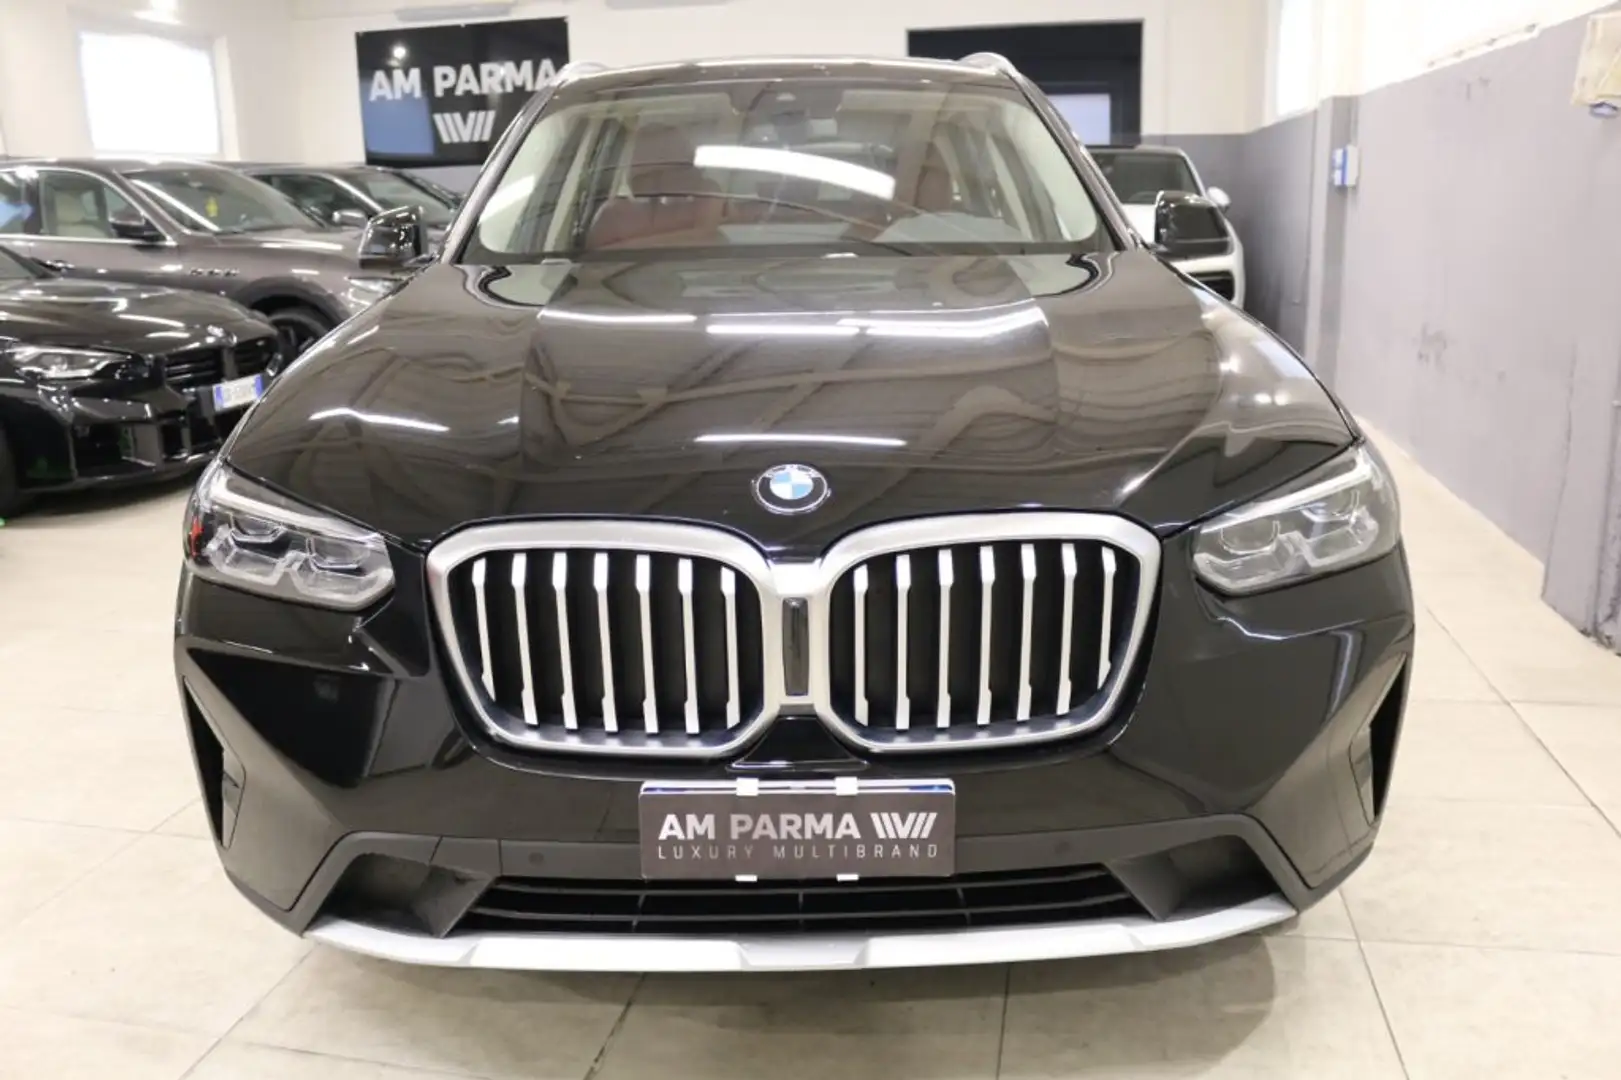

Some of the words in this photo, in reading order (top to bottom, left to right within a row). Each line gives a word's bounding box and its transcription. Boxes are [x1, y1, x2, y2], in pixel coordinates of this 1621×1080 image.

[369, 67, 422, 101] AM
[433, 58, 557, 98] PARMA
[658, 813, 715, 840] AM
[730, 812, 861, 840] PARMA
[658, 844, 753, 859] LUXURY
[773, 844, 938, 859] MULTIBRAND
